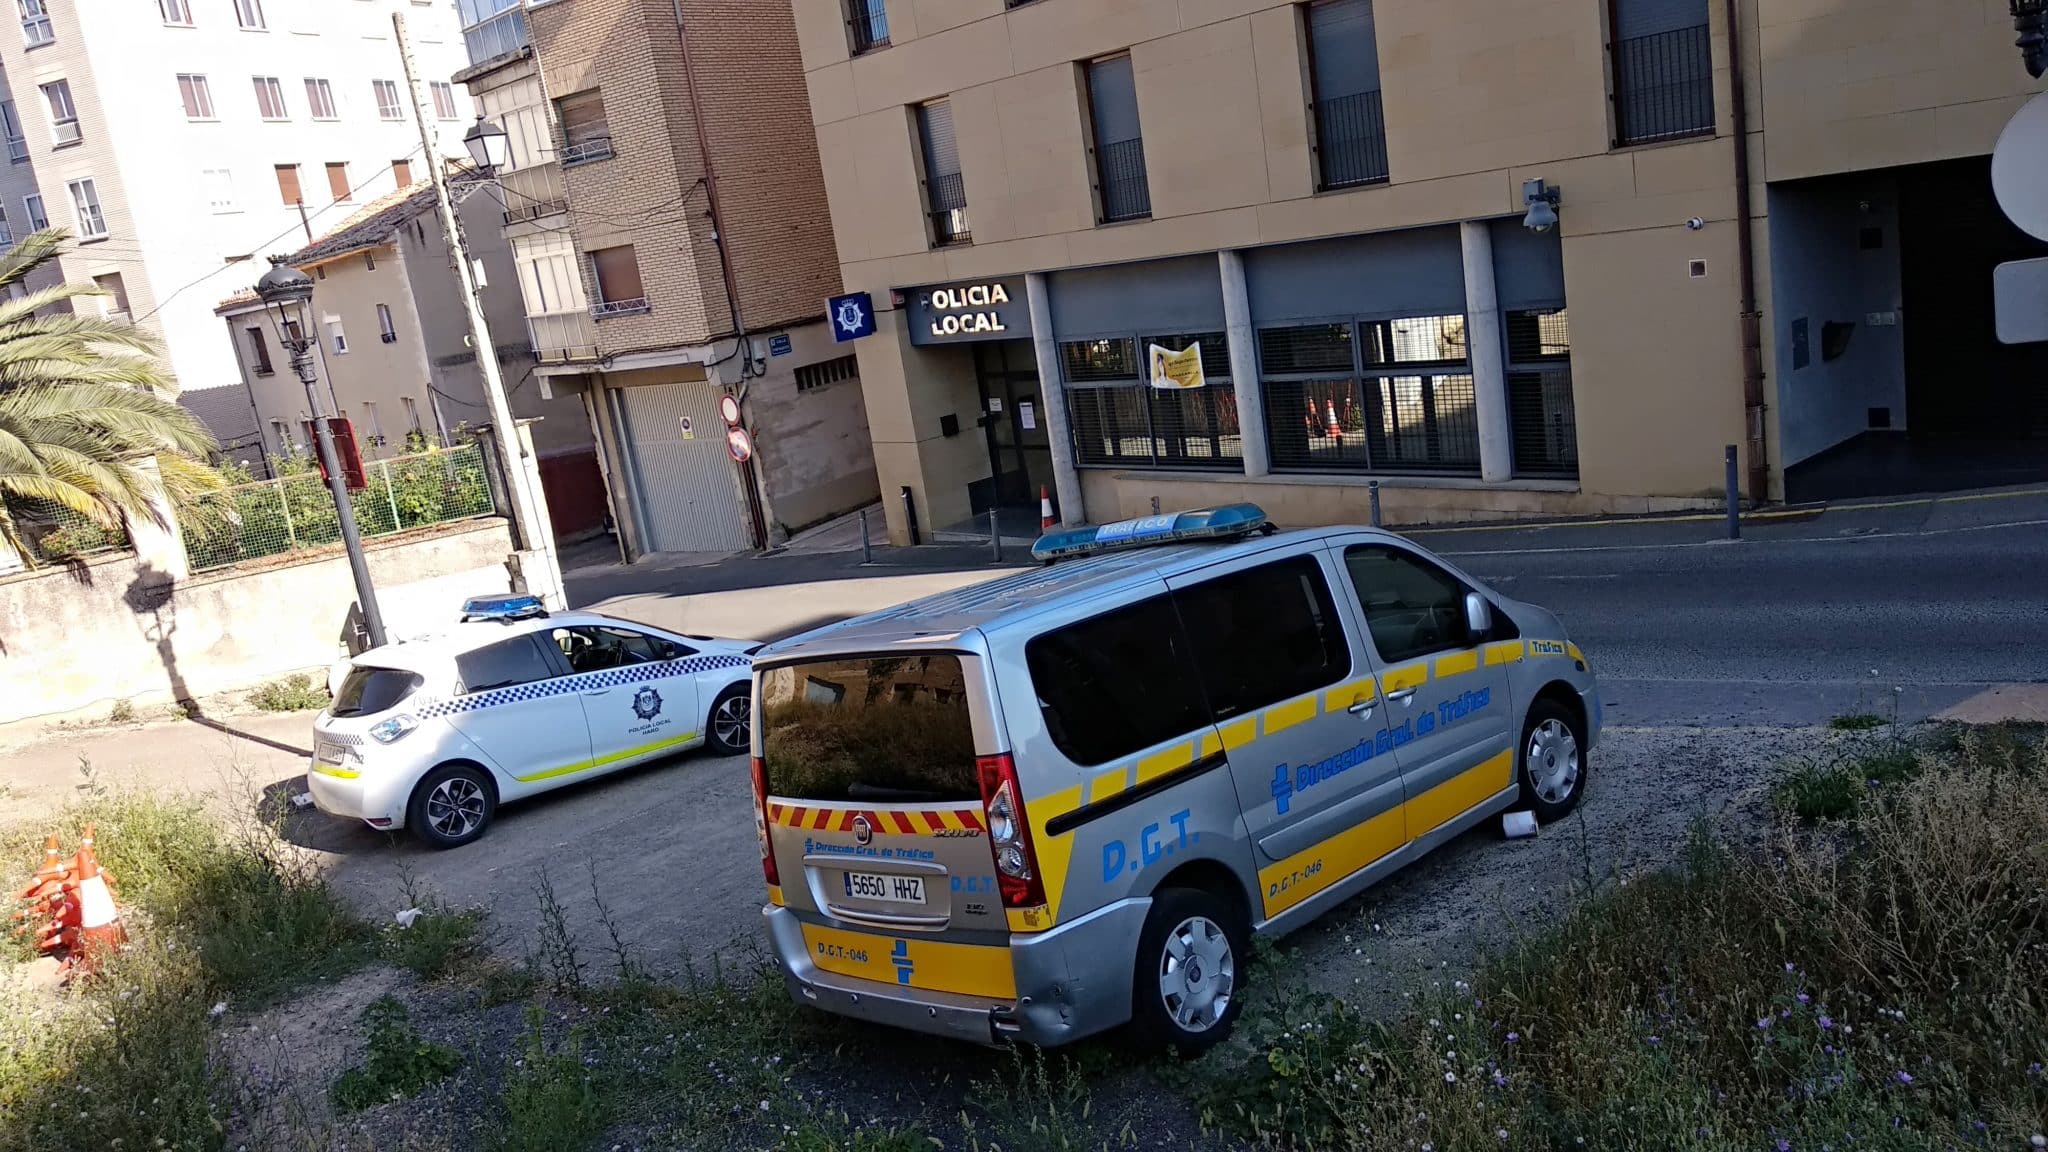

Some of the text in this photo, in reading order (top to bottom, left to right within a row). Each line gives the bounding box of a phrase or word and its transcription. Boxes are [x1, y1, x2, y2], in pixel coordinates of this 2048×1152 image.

[931, 312, 1005, 336] LOCAL
[1296, 738, 1374, 792] Dirección
[1416, 709, 1436, 736] de
[1438, 686, 1490, 726] Tráfico
[852, 874, 922, 901] 5650 HHZ
